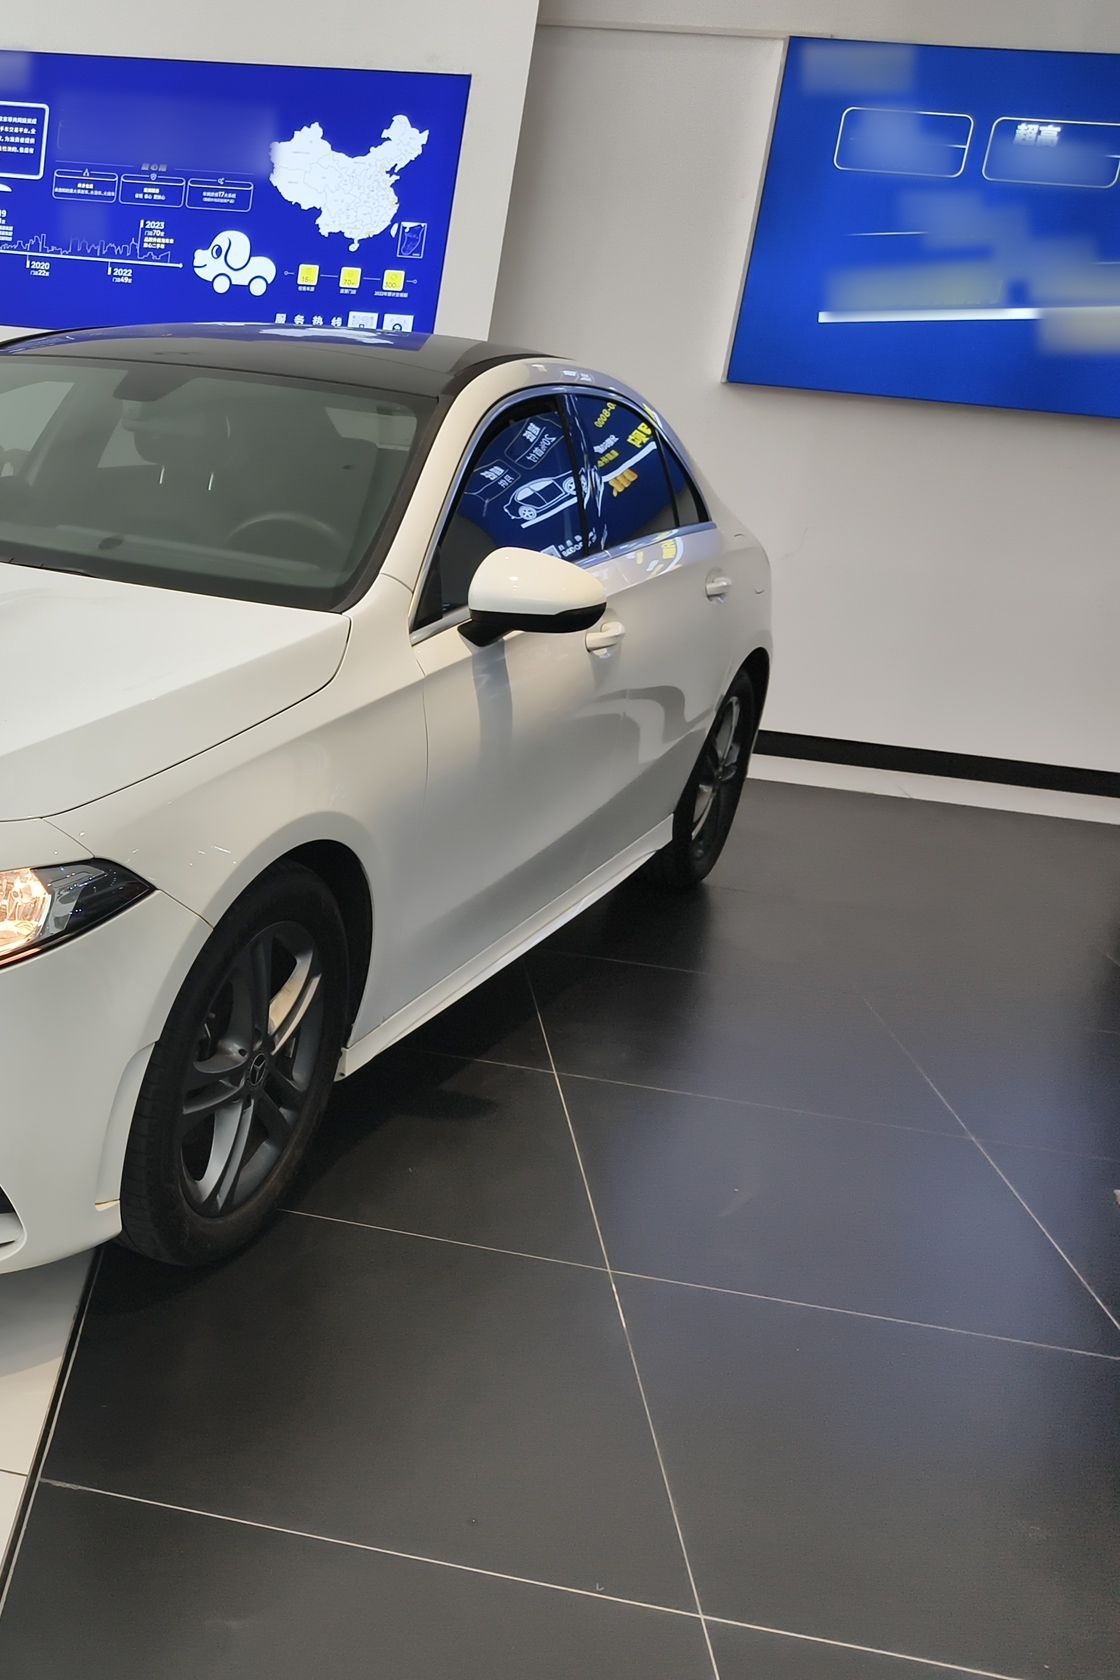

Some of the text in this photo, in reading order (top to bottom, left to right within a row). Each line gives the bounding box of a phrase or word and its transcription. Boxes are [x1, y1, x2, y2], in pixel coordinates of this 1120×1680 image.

[1013, 123, 1061, 147] 超高
[145, 221, 165, 229] 2023
[31, 261, 50, 270] 2020
[113, 268, 132, 277] 2022
